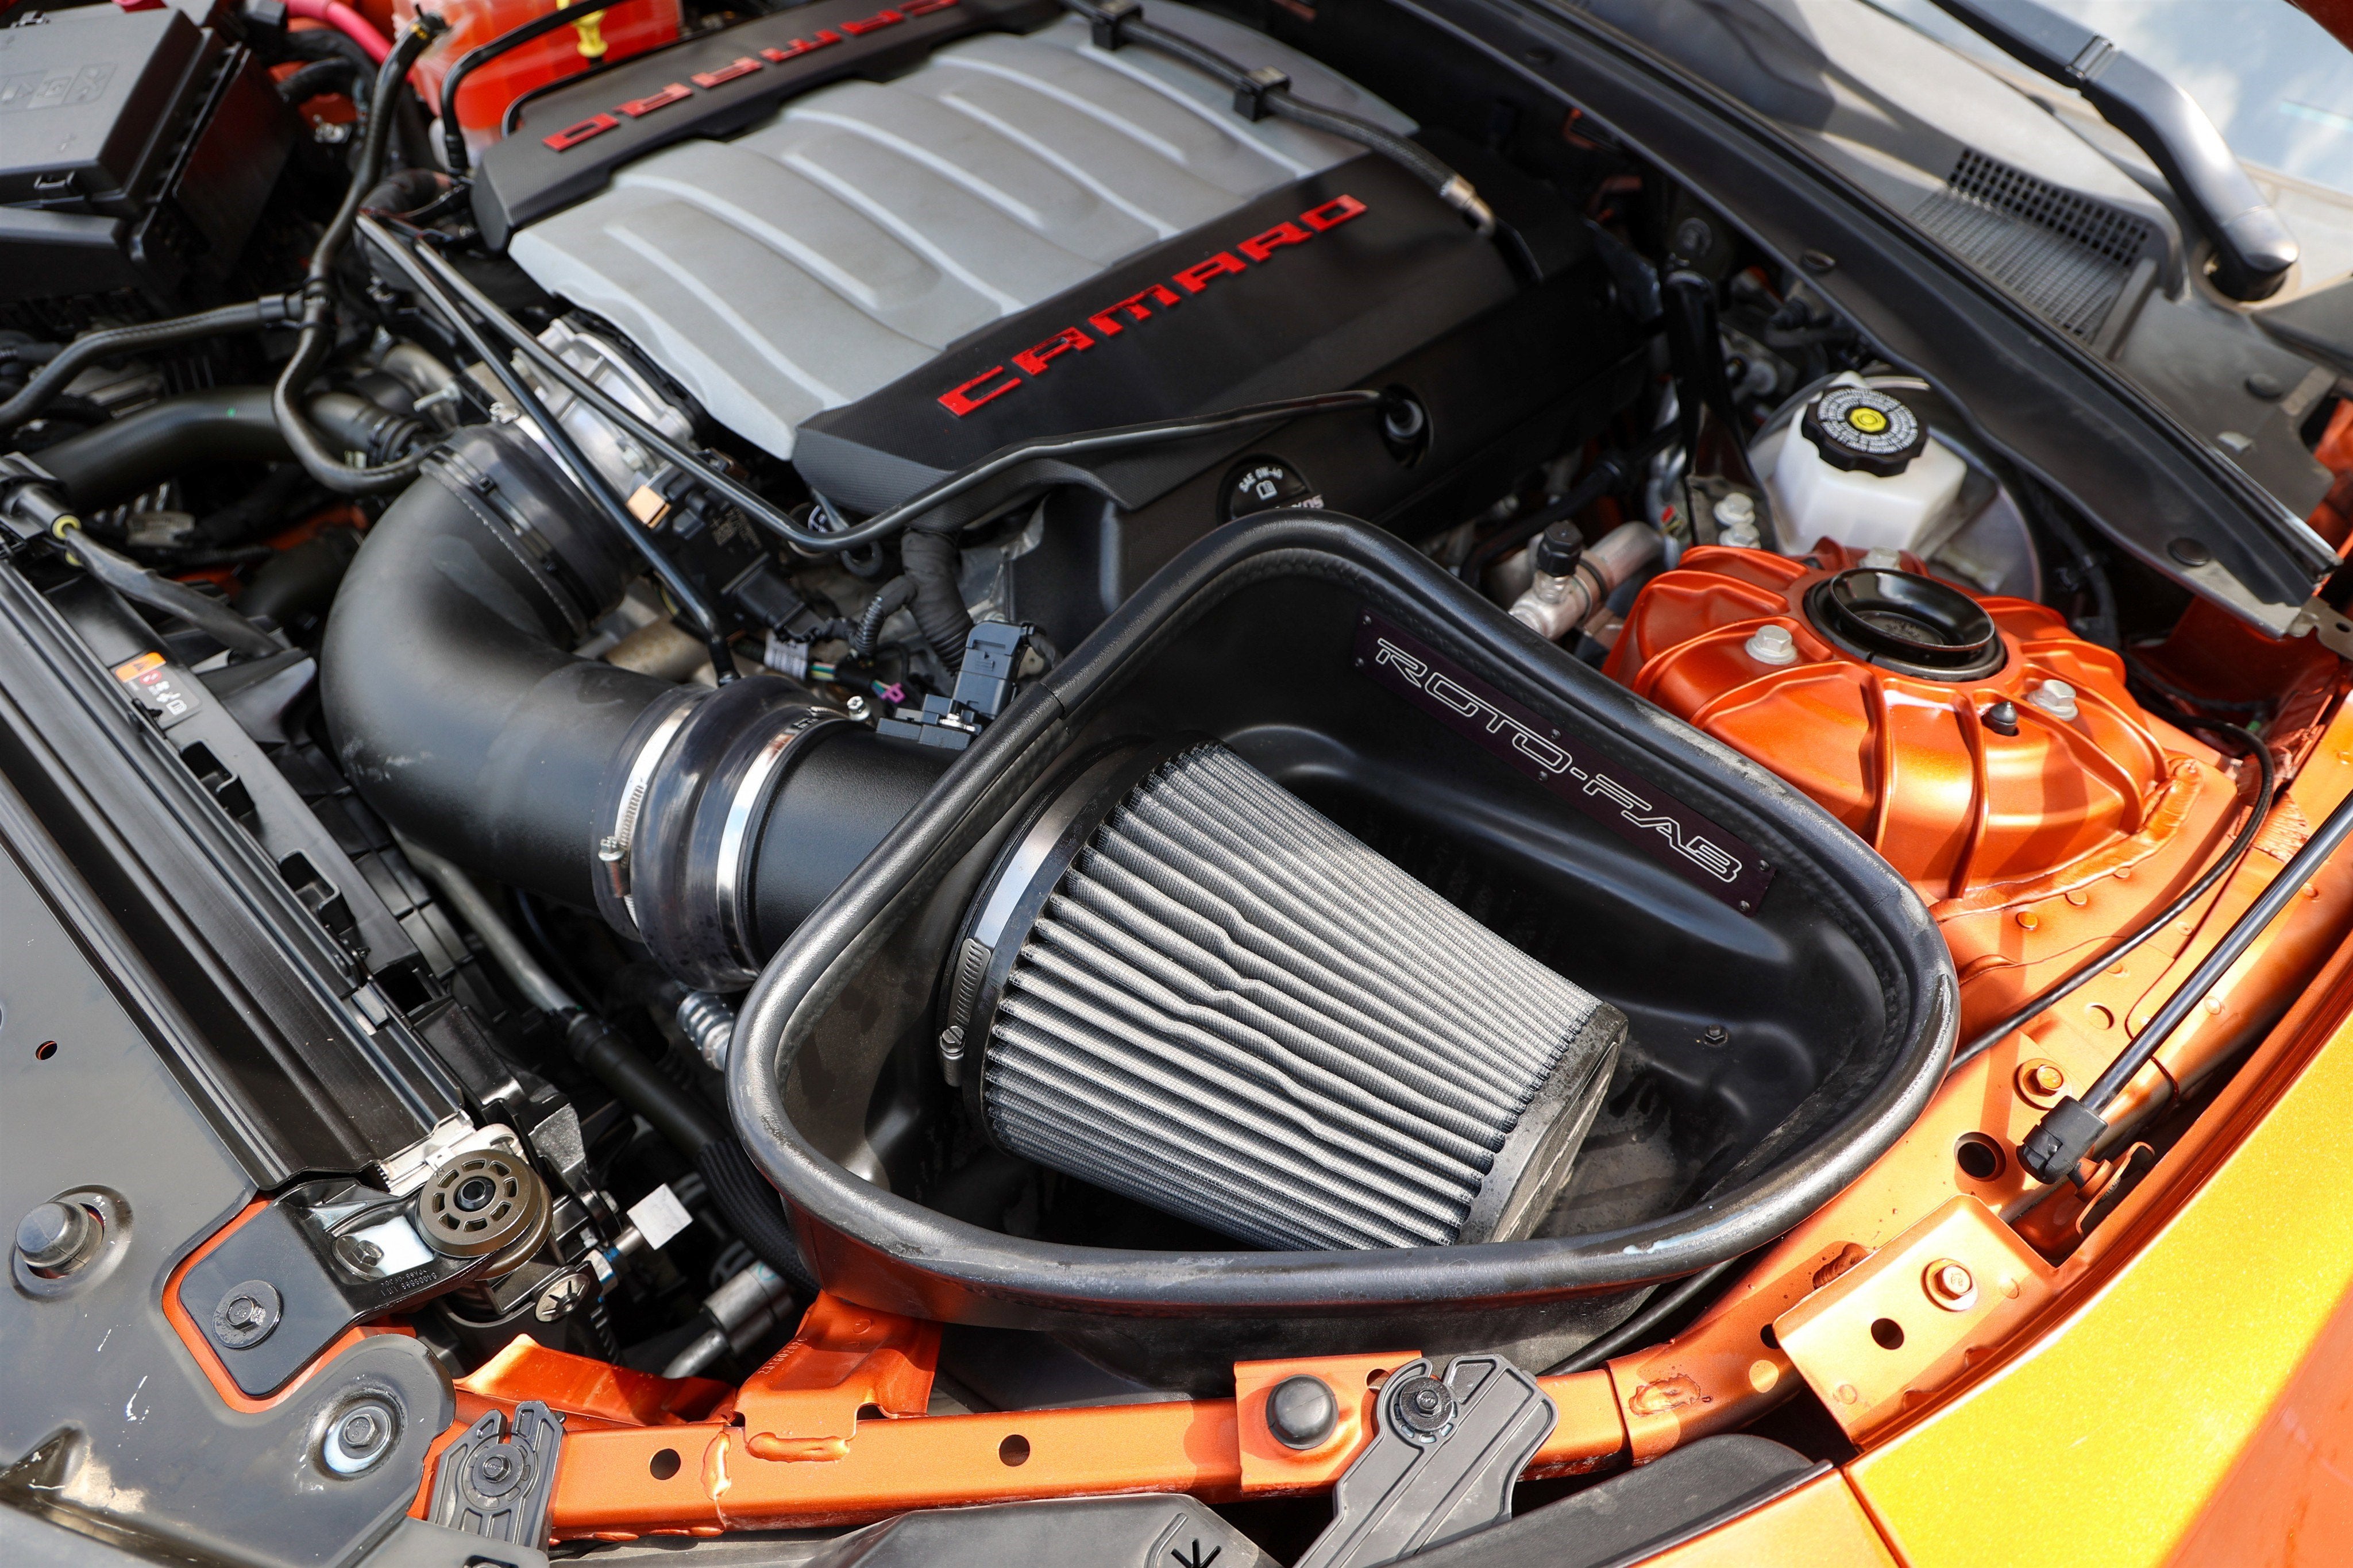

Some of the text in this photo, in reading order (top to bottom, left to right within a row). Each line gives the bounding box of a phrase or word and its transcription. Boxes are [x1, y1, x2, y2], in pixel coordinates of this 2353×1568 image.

[936, 193, 1368, 418] CAMARO
[1239, 466, 1283, 493] SAE 0W-40
[1375, 637, 1743, 884] ROTO-FAB
